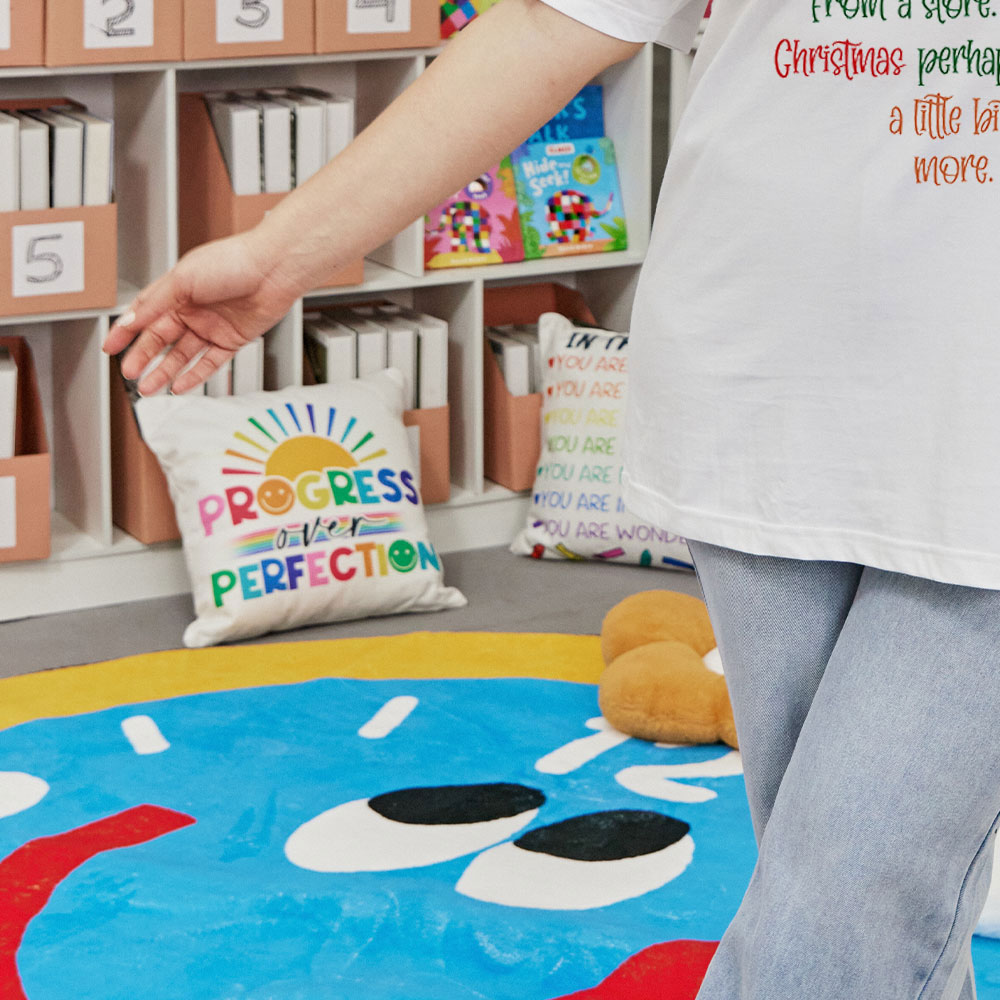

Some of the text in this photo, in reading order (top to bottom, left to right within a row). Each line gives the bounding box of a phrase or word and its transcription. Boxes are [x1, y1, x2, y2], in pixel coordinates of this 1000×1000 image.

[773, 37, 907, 81] Christmas
[889, 105, 903, 136] a
[913, 92, 963, 138] little
[913, 153, 994, 186] more.
[25, 233, 65, 284] 5
[595, 356, 628, 374] ARE
[589, 381, 625, 399] ARE
[585, 408, 620, 427] ARE
[582, 436, 617, 455] ARE
[578, 464, 614, 484] ARE
[576, 493, 612, 512] ARE
[275, 514, 388, 550] over
[576, 521, 610, 540] ARE
[211, 538, 441, 608] PERFECTION
